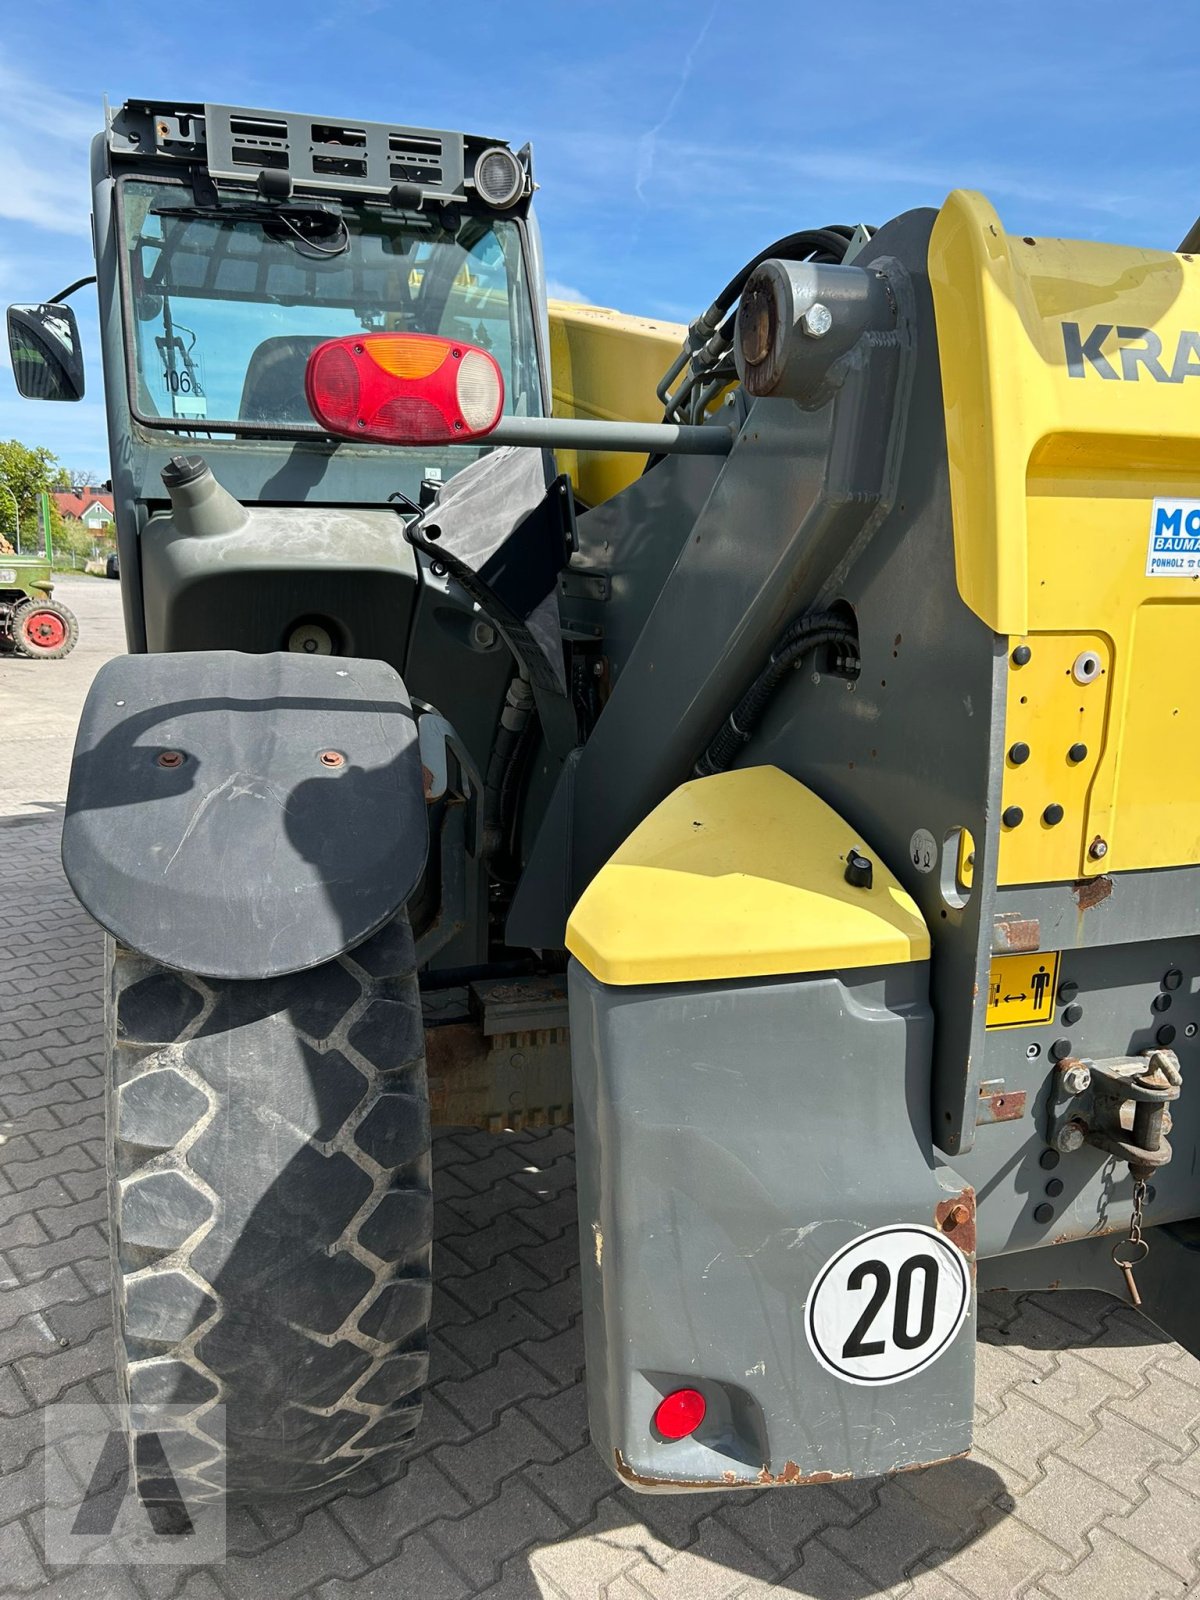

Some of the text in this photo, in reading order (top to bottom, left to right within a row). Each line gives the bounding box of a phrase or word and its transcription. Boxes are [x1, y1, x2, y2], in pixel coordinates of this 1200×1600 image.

[1061, 321, 1200, 384] KRA
[163, 370, 191, 393] 106
[1155, 507, 1200, 537] MO
[1151, 558, 1184, 568] PONHOLZ
[841, 1253, 939, 1359] 20
